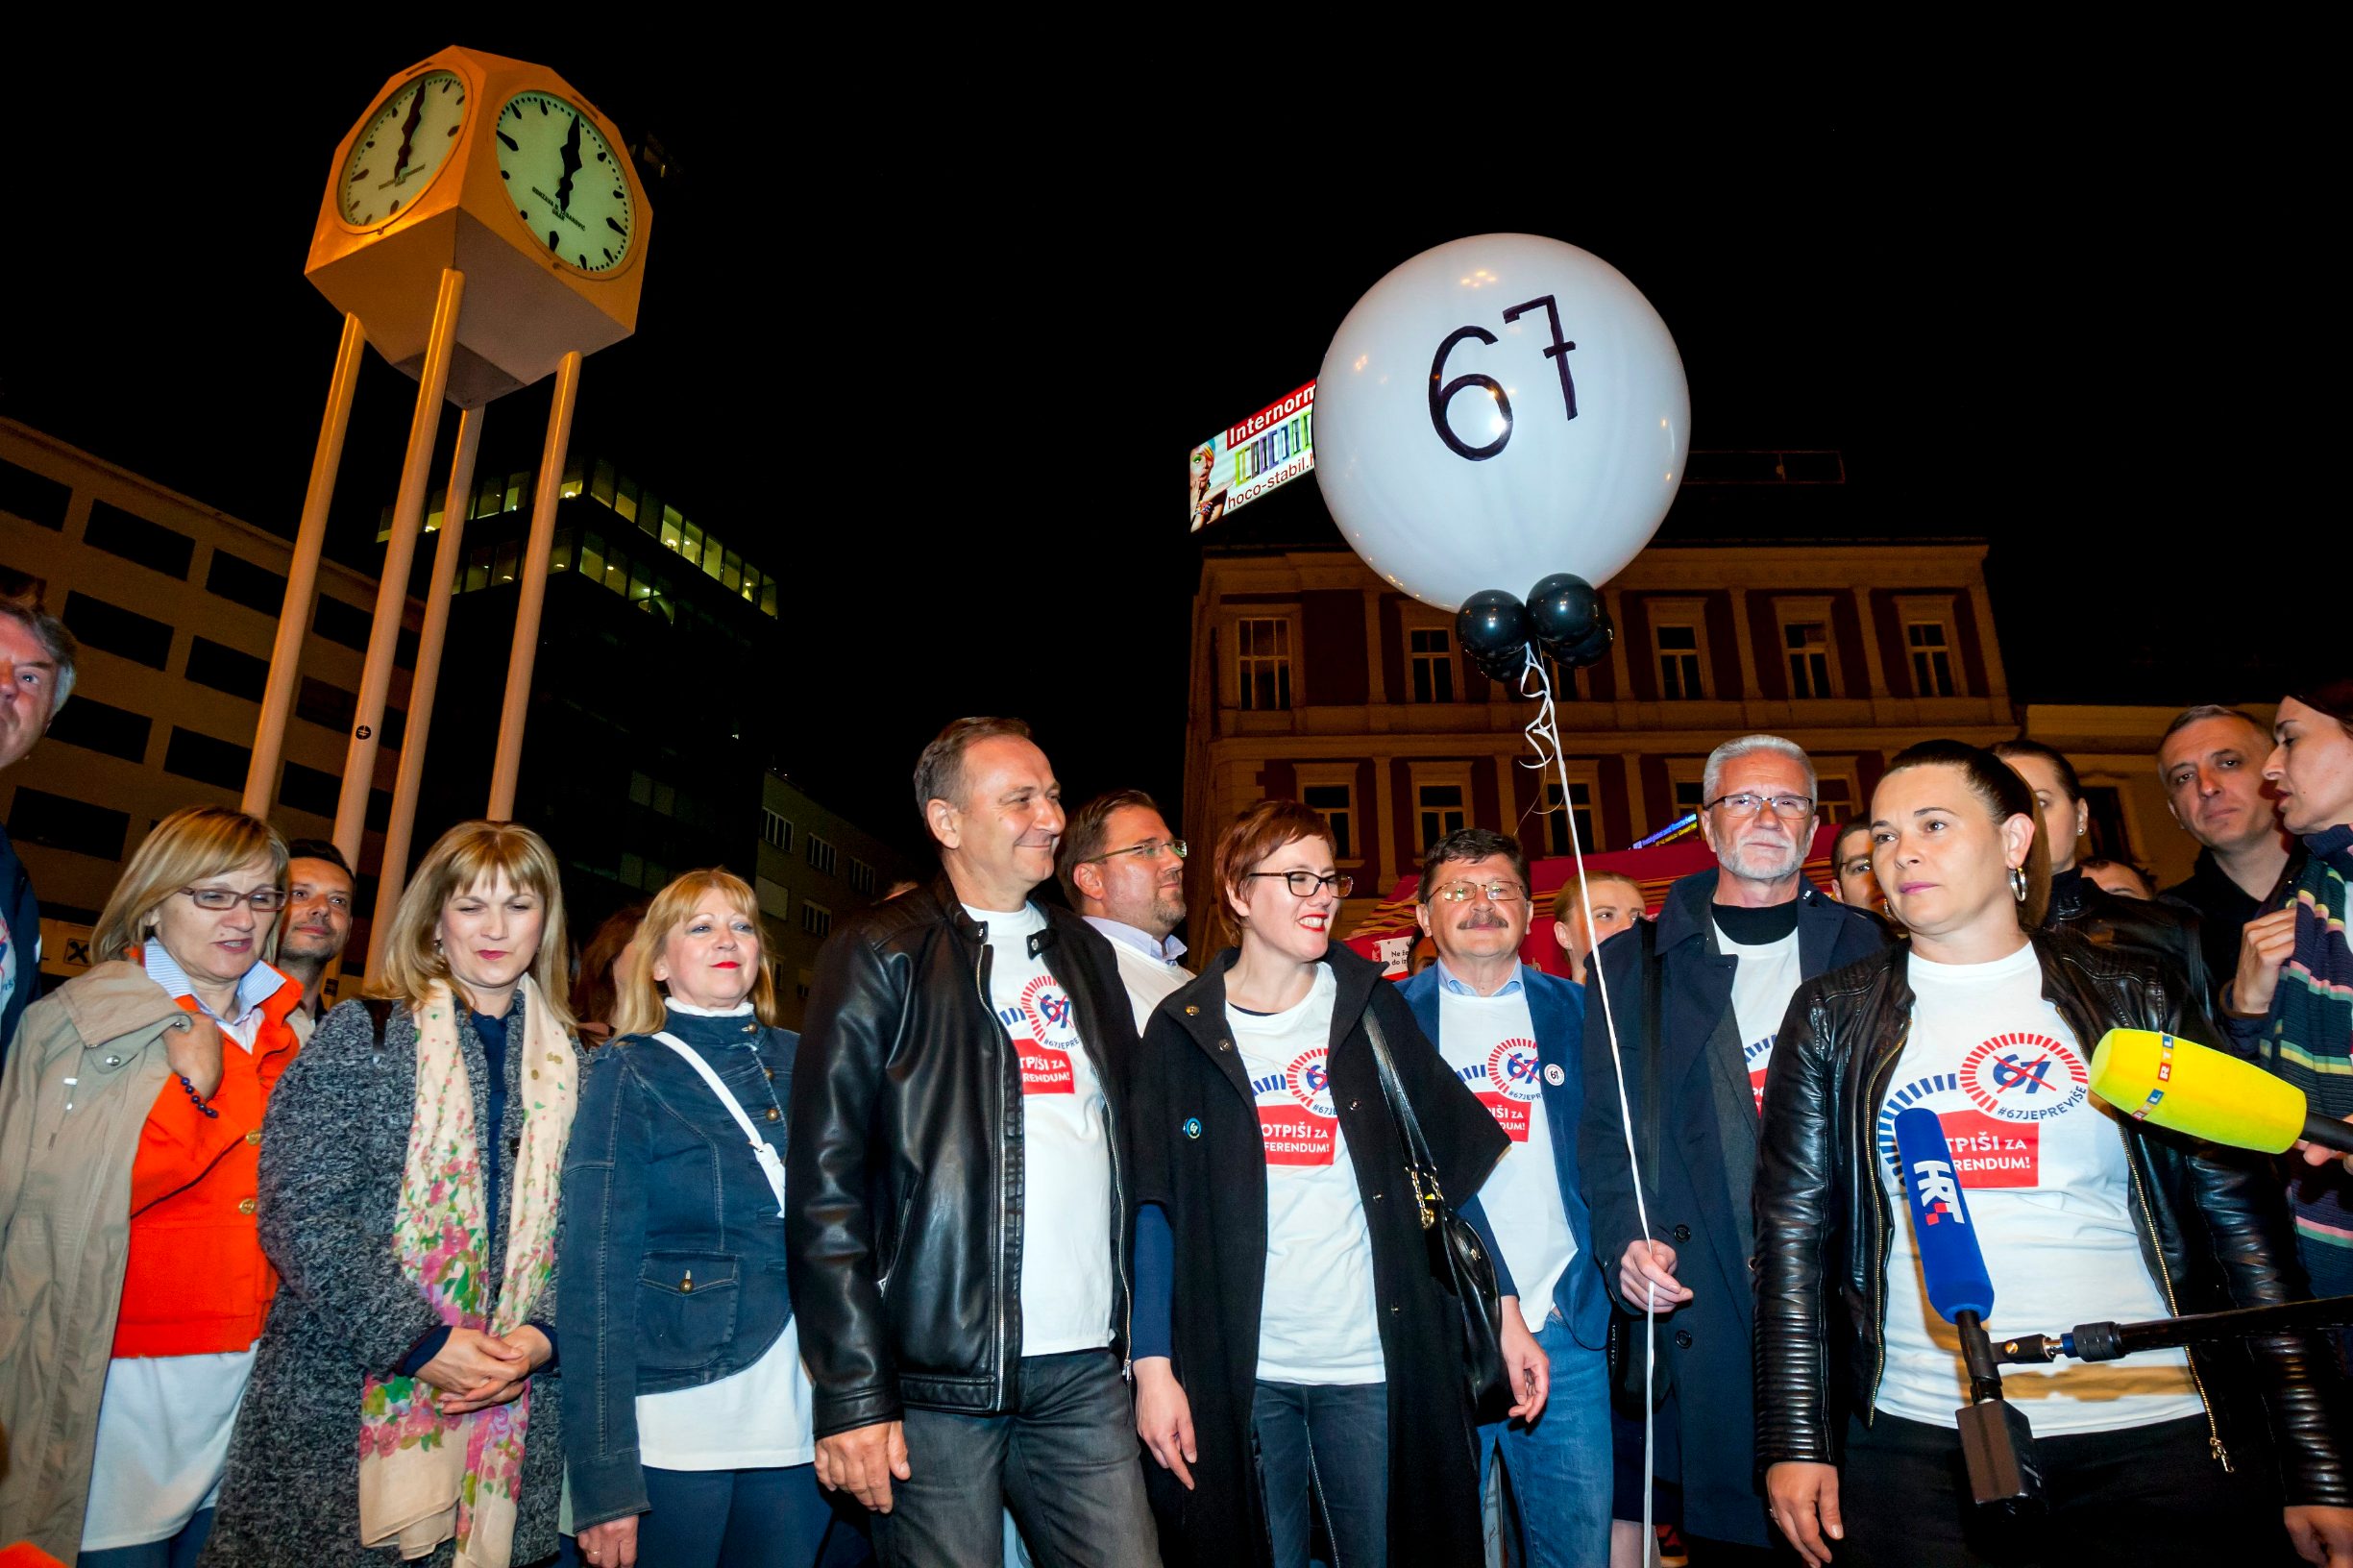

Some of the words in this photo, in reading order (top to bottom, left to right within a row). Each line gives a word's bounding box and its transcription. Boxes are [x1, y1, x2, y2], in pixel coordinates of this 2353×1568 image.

[1429, 294, 1578, 461] 67
[1040, 993, 1070, 1028] 67
[1051, 1059, 1066, 1069] ZA
[1507, 1053, 1539, 1084] 67
[1993, 1054, 2051, 1094] 67
[2158, 1035, 2174, 1082] RTL
[1022, 1072, 1070, 1083] RENDUM!
[1550, 1070, 1559, 1079] 67
[1510, 1111, 1524, 1119] ZA
[1997, 1085, 2087, 1120] #67JEPREVIŠE
[1314, 1129, 1329, 1139] ZA
[2004, 1139, 2027, 1150] ZA
[1914, 1160, 1965, 1224] HRT
